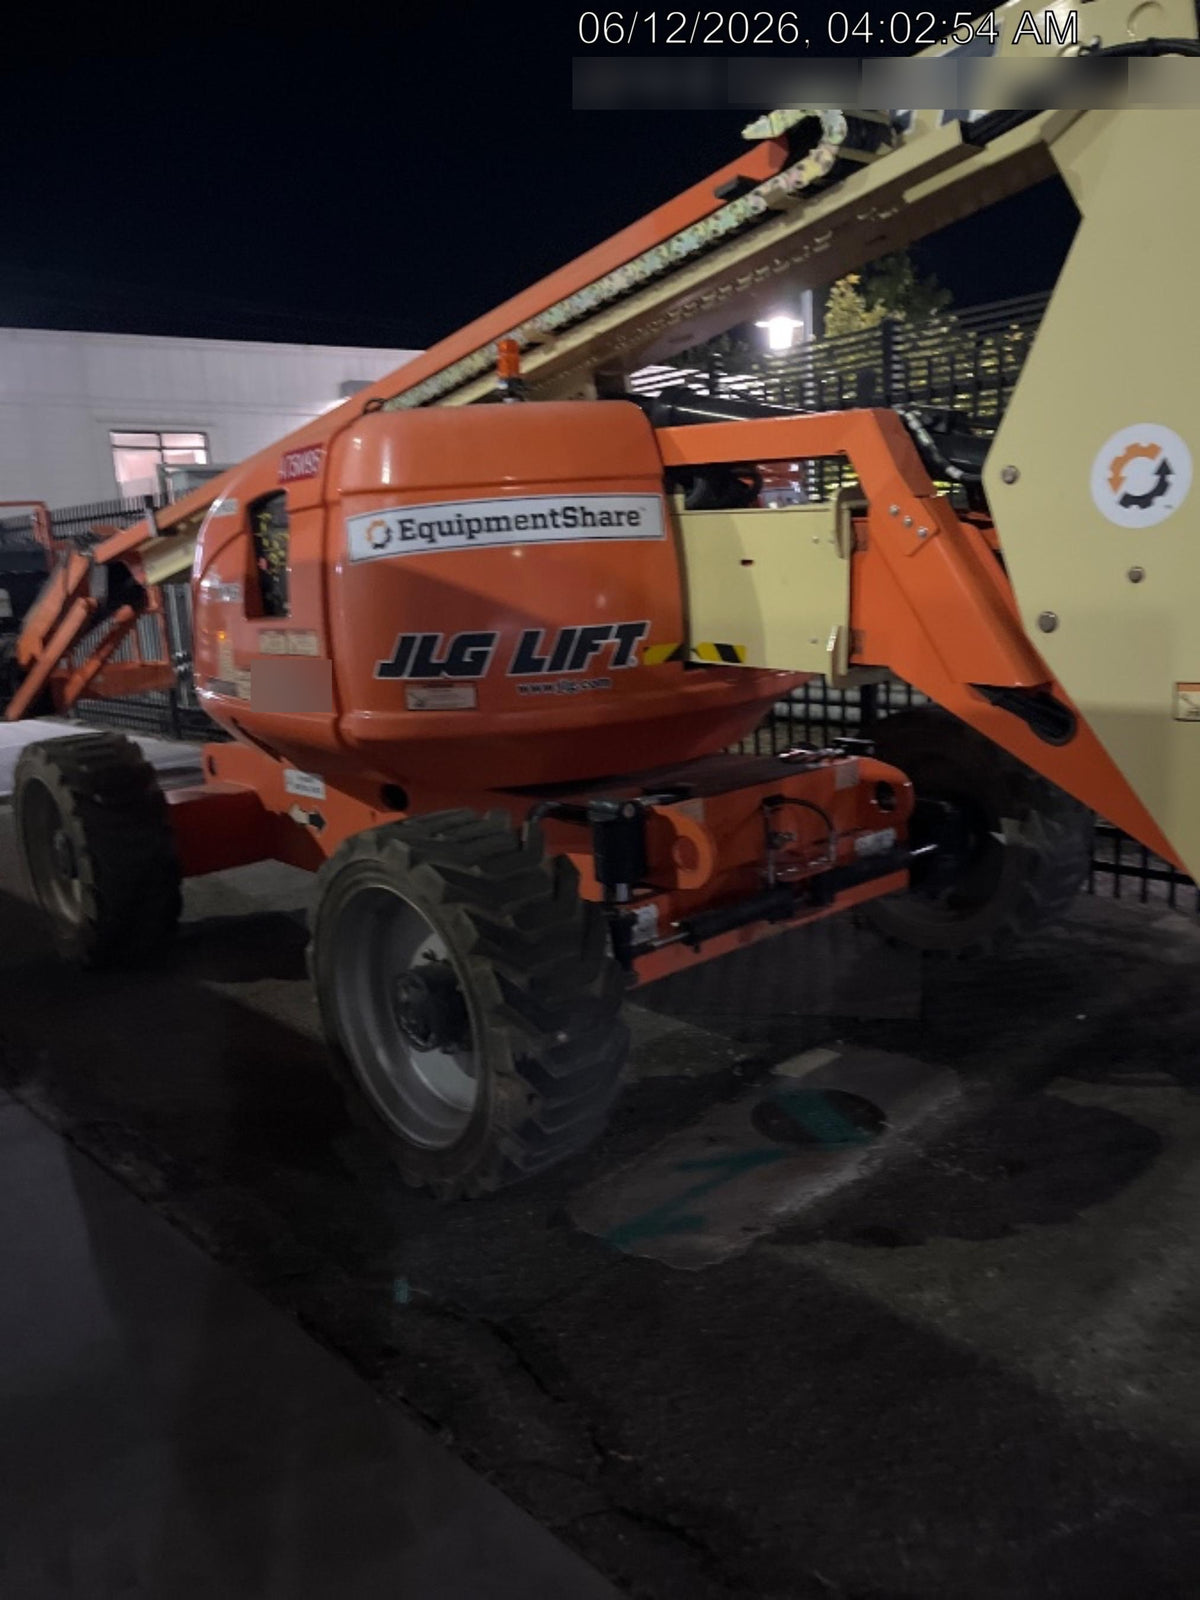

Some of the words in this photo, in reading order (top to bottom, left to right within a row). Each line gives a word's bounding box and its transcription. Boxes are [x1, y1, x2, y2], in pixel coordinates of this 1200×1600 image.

[398, 506, 641, 543] EquipmentShare
[376, 632, 498, 678] JLG
[508, 621, 649, 674] LIFT
